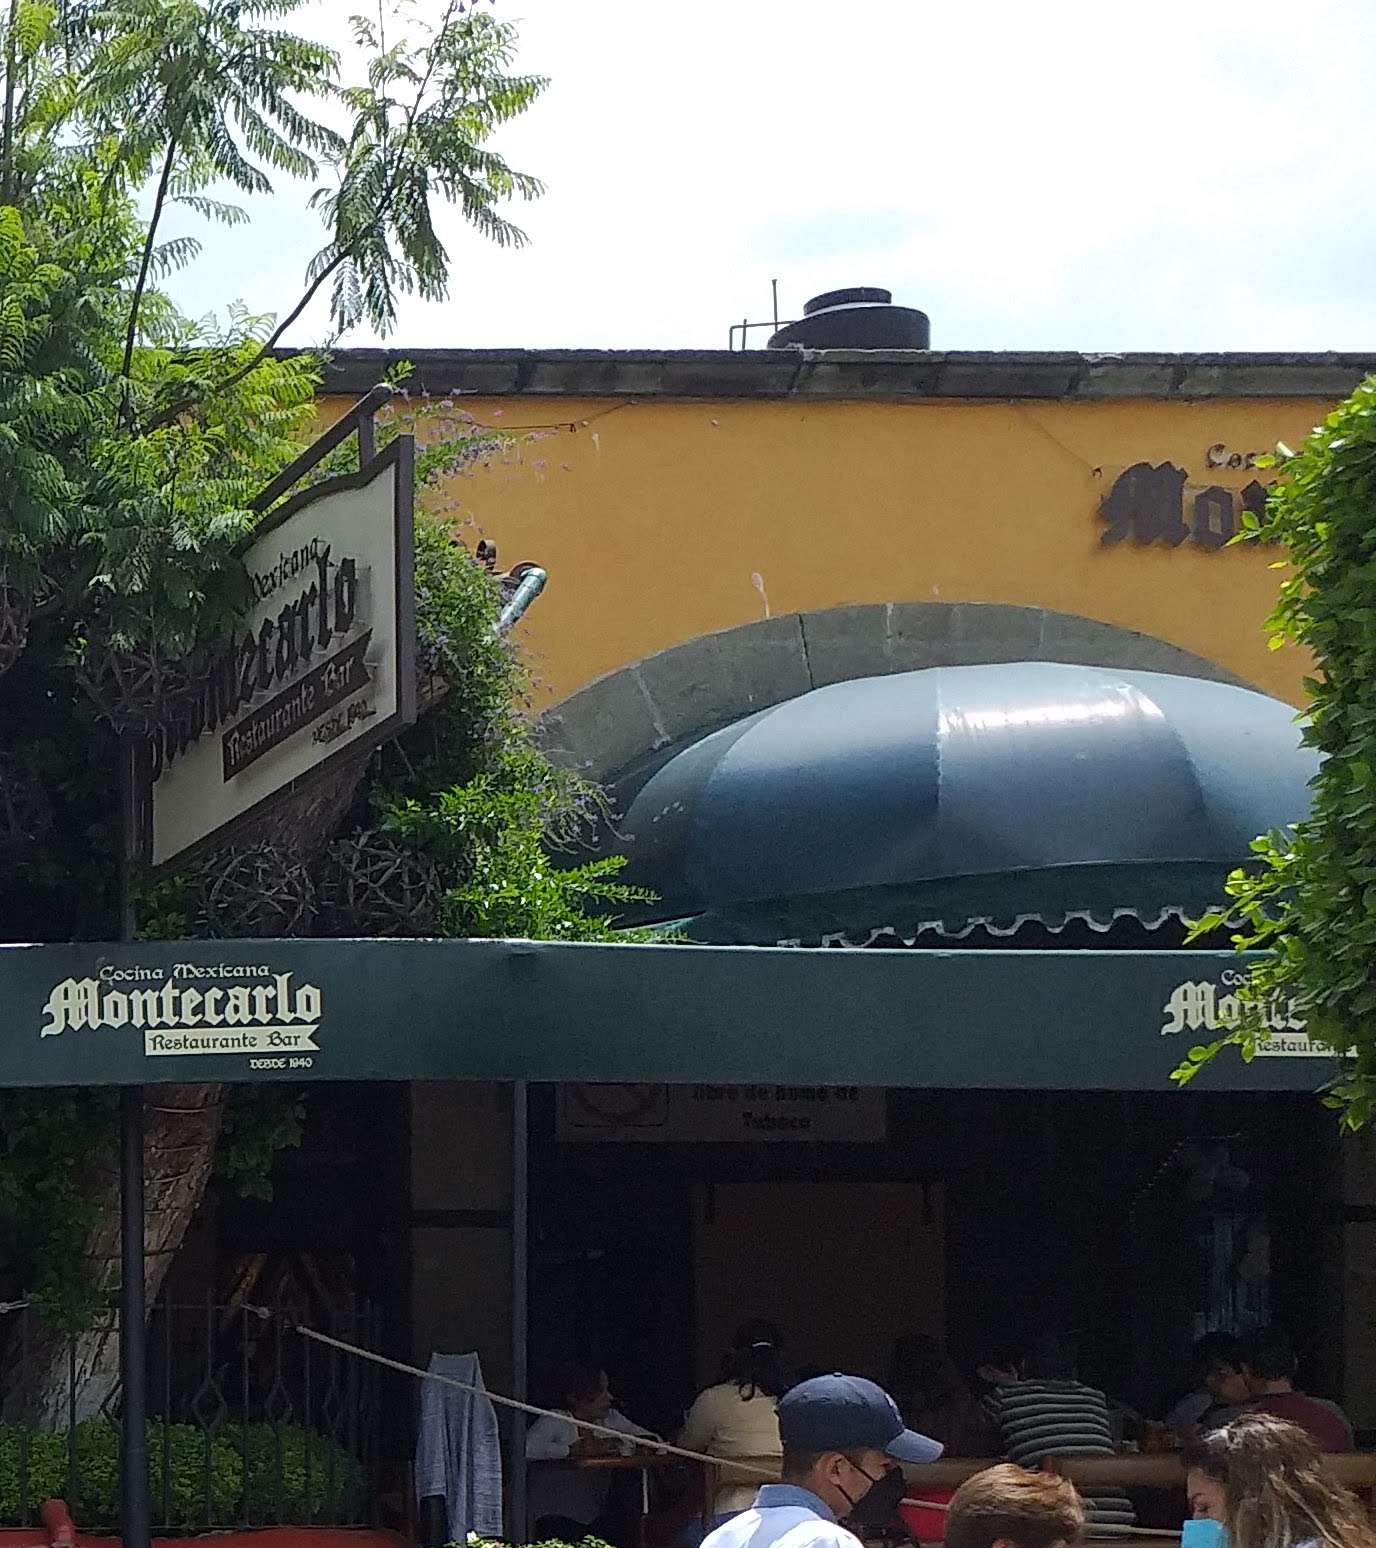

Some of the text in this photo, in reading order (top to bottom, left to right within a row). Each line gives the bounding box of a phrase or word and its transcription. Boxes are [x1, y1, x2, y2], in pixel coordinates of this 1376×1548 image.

[227, 656, 355, 767] Restaurante Bar
[99, 962, 270, 983] Cocina Mexicana
[40, 971, 322, 1039] Montecarlo
[149, 1031, 301, 1051] Restaurante Bar
[250, 1056, 313, 1070] DESDE 1940
